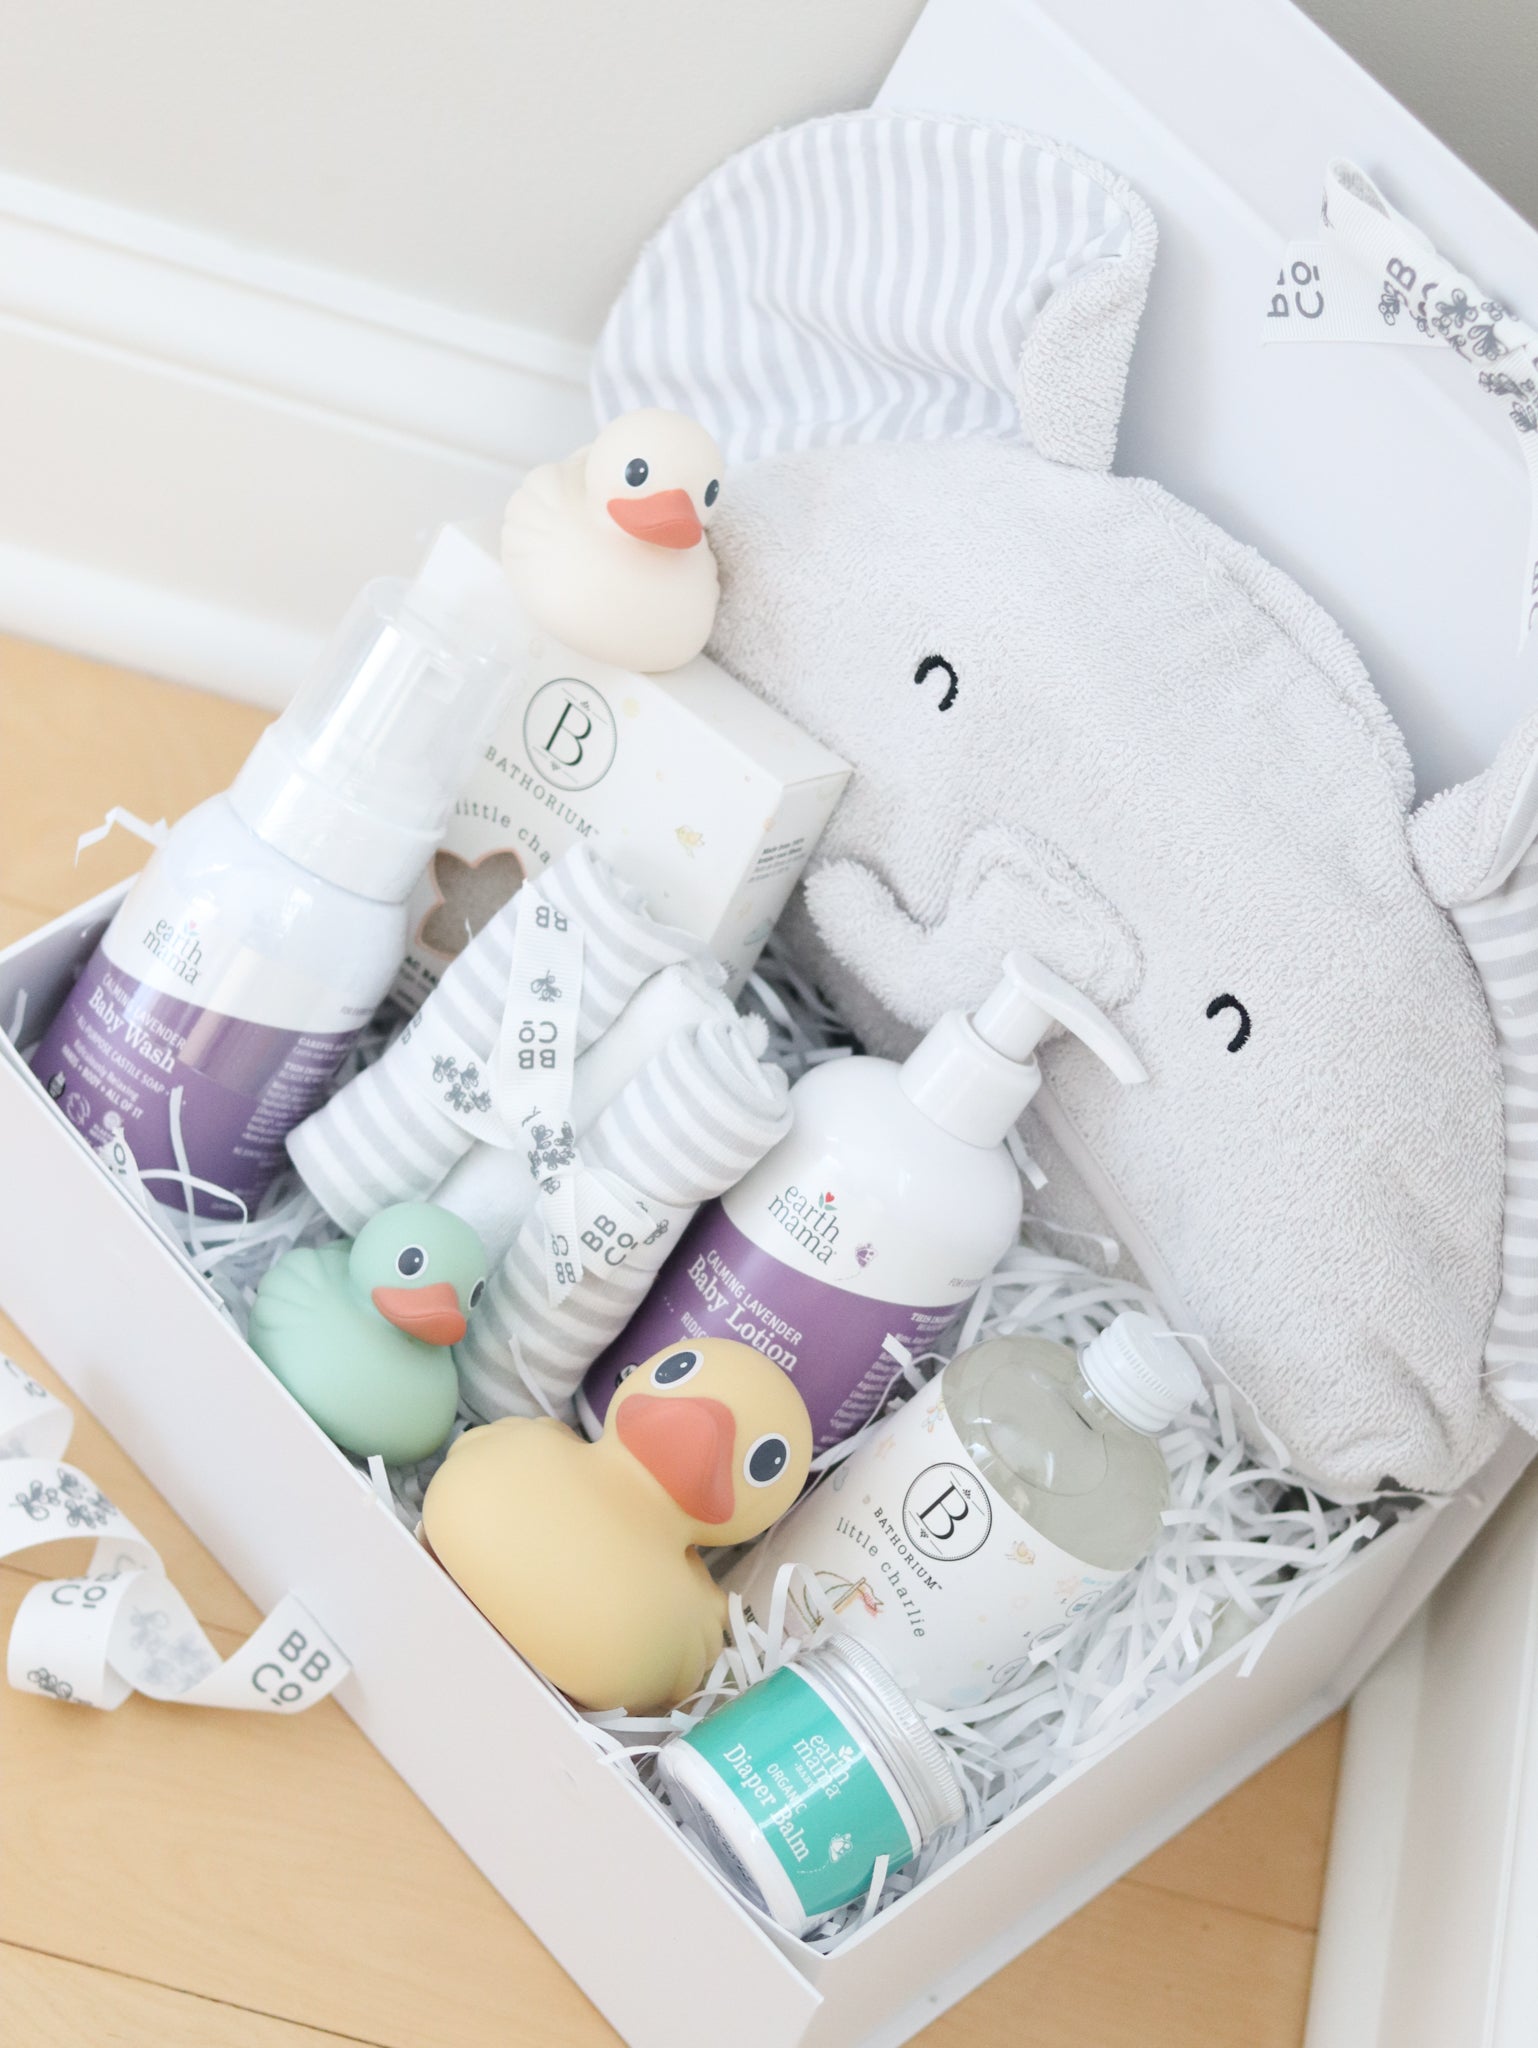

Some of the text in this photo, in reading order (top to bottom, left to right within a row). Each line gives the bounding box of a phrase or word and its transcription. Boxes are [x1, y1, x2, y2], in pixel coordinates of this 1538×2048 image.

[545, 701, 592, 767] B
[518, 825, 551, 864] cha
[142, 929, 200, 987] mama
[155, 919, 202, 966] earth
[88, 984, 176, 1074] Baby Wash
[134, 1007, 187, 1050] LAVENDER
[109, 1049, 142, 1079] CASTILE
[138, 1073, 166, 1095] SOAP
[518, 1049, 556, 1069] BB
[104, 1087, 122, 1105] ALL
[118, 1098, 135, 1113] OF
[130, 1106, 144, 1119] IT
[580, 1214, 617, 1253] BB
[768, 1195, 834, 1265] mama
[784, 1185, 840, 1244] earth
[680, 1311, 711, 1339] RIDIC
[687, 1253, 798, 1372] Baby Lotion
[706, 1249, 804, 1346] CALMING LAVENDER
[916, 1480, 970, 1541] B
[835, 1516, 925, 1639] little charlie
[743, 1604, 759, 1626] BU
[278, 1630, 331, 1683] BB
[792, 1738, 840, 1800] mama
[809, 1734, 850, 1787] earth
[723, 1742, 777, 1808] Diaper
[770, 1804, 811, 1863] Balm
